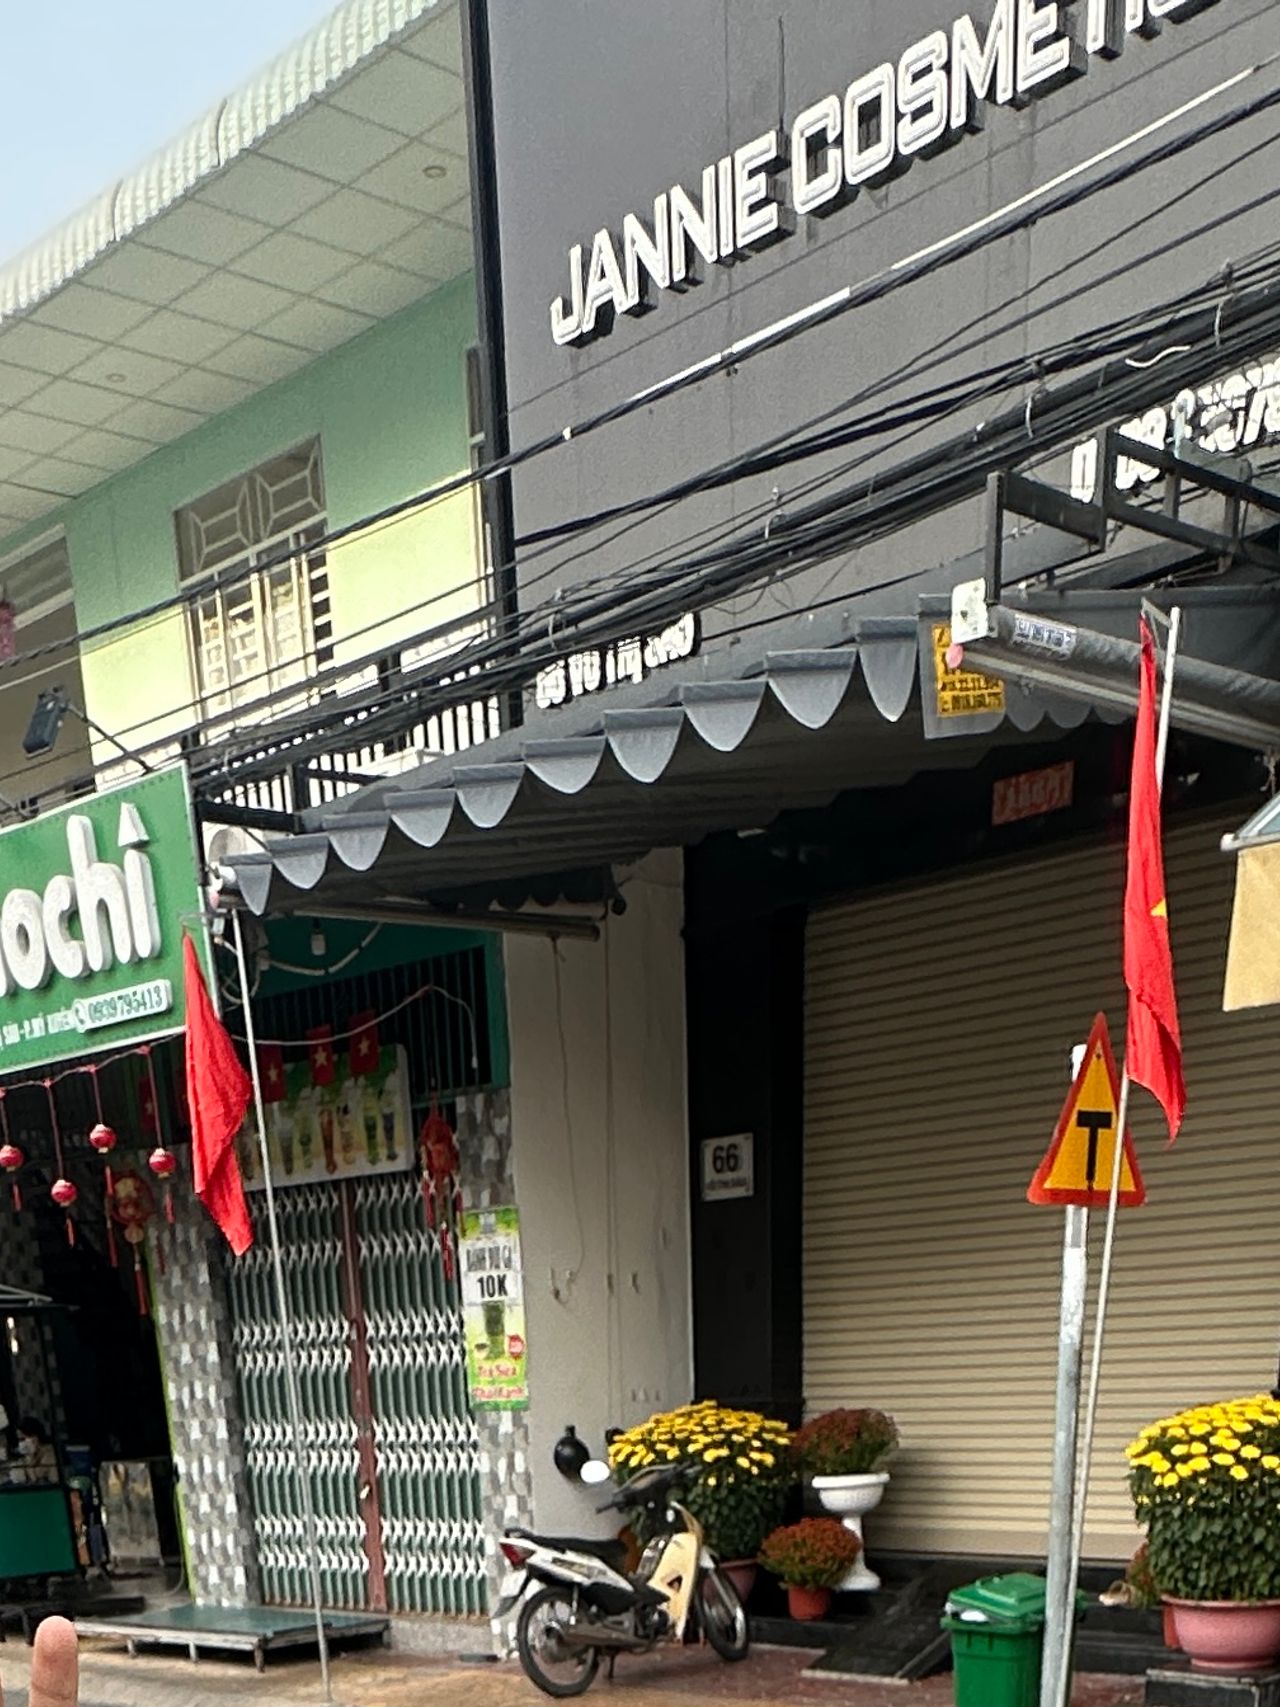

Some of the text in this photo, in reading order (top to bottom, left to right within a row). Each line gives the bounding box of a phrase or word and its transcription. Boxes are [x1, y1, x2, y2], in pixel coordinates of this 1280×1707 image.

[549, 131, 778, 345] JANNIE
[712, 1142, 739, 1175] 66
[477, 1274, 508, 1299] 10K
